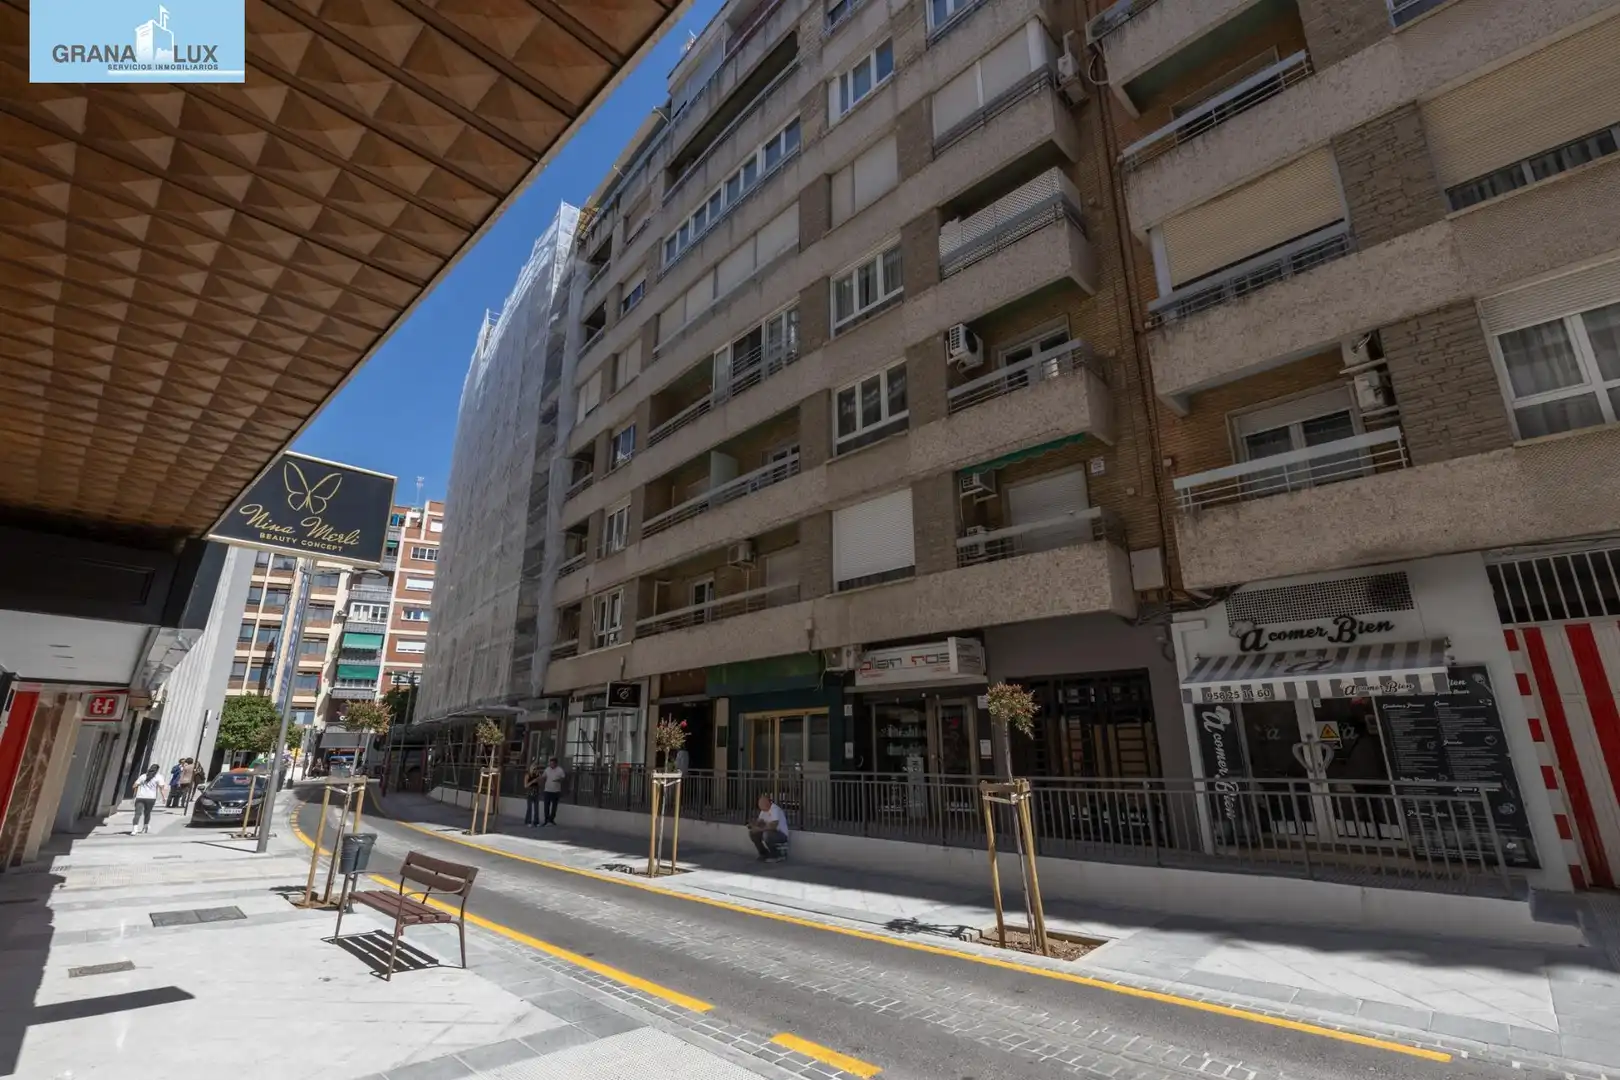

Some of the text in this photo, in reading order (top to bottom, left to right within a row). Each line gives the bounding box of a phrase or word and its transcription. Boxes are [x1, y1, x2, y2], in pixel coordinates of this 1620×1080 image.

[239, 503, 361, 546] Nina Merli
[259, 532, 343, 552] BEAUTY CONCEPT
[1268, 626, 1328, 642] comer
[1328, 615, 1395, 644] Bien
[1207, 688, 1270, 700] 958 25 11 60
[1385, 680, 1413, 693] Bien
